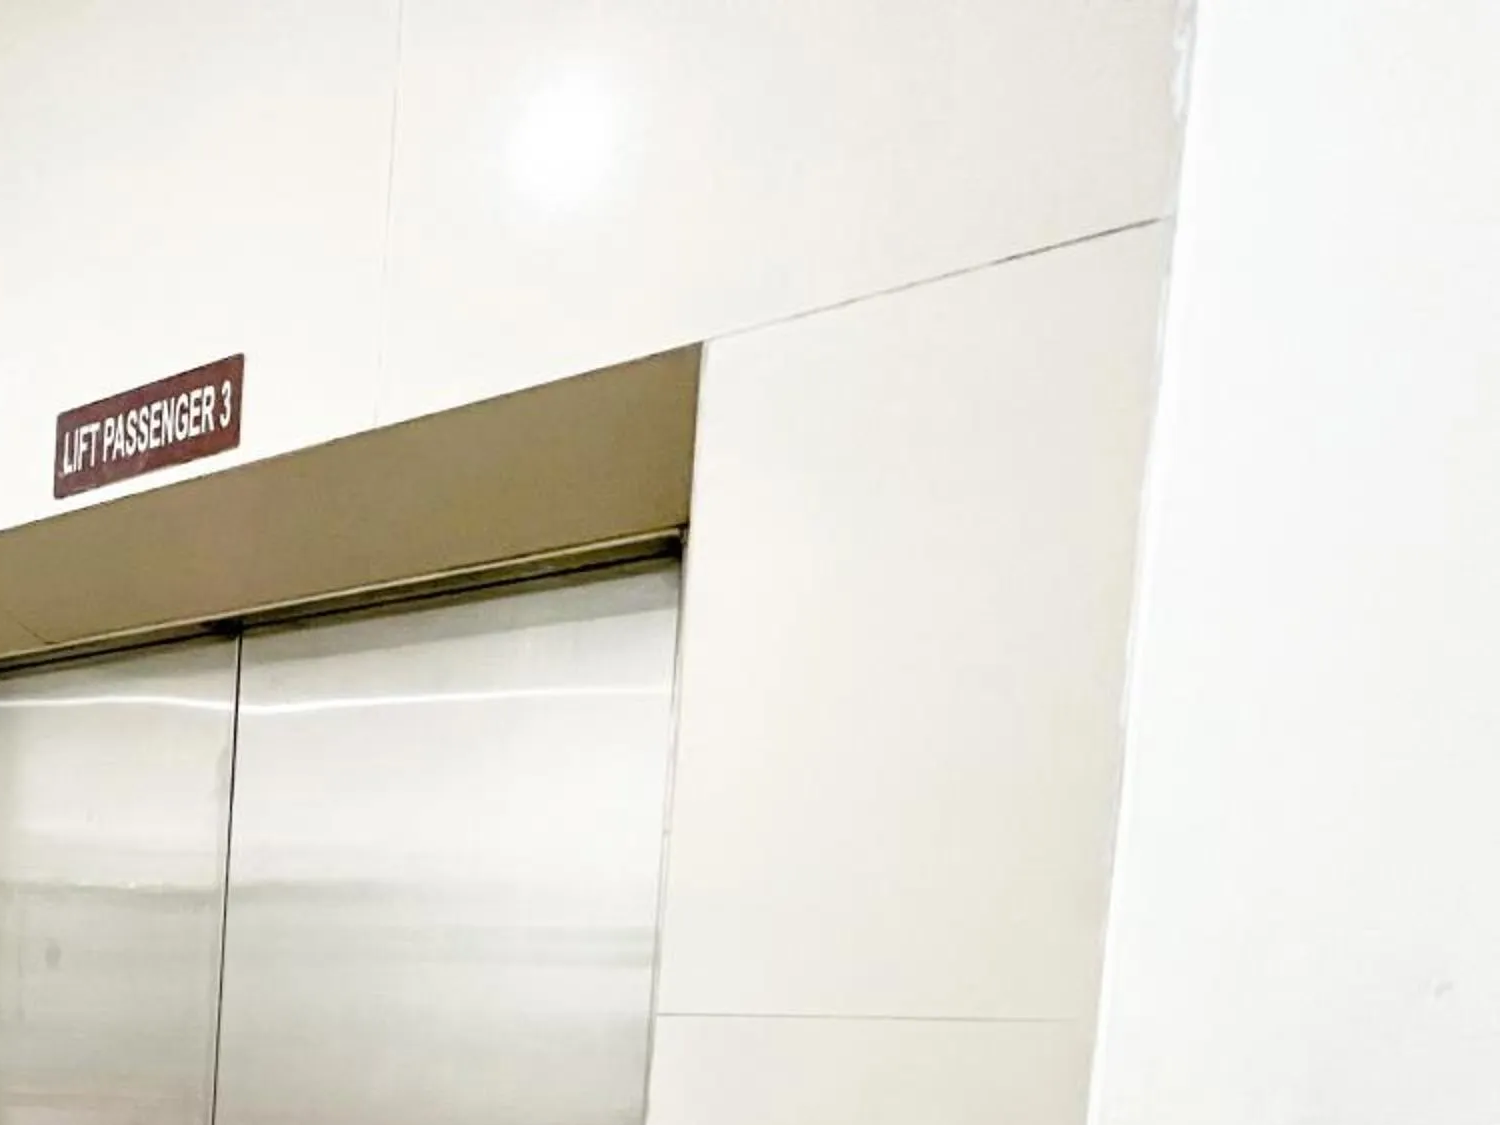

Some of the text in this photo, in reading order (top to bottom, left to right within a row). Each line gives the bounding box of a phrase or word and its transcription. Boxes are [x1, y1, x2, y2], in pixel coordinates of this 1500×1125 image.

[63, 380, 232, 474] LIFT PASSENGER 3
